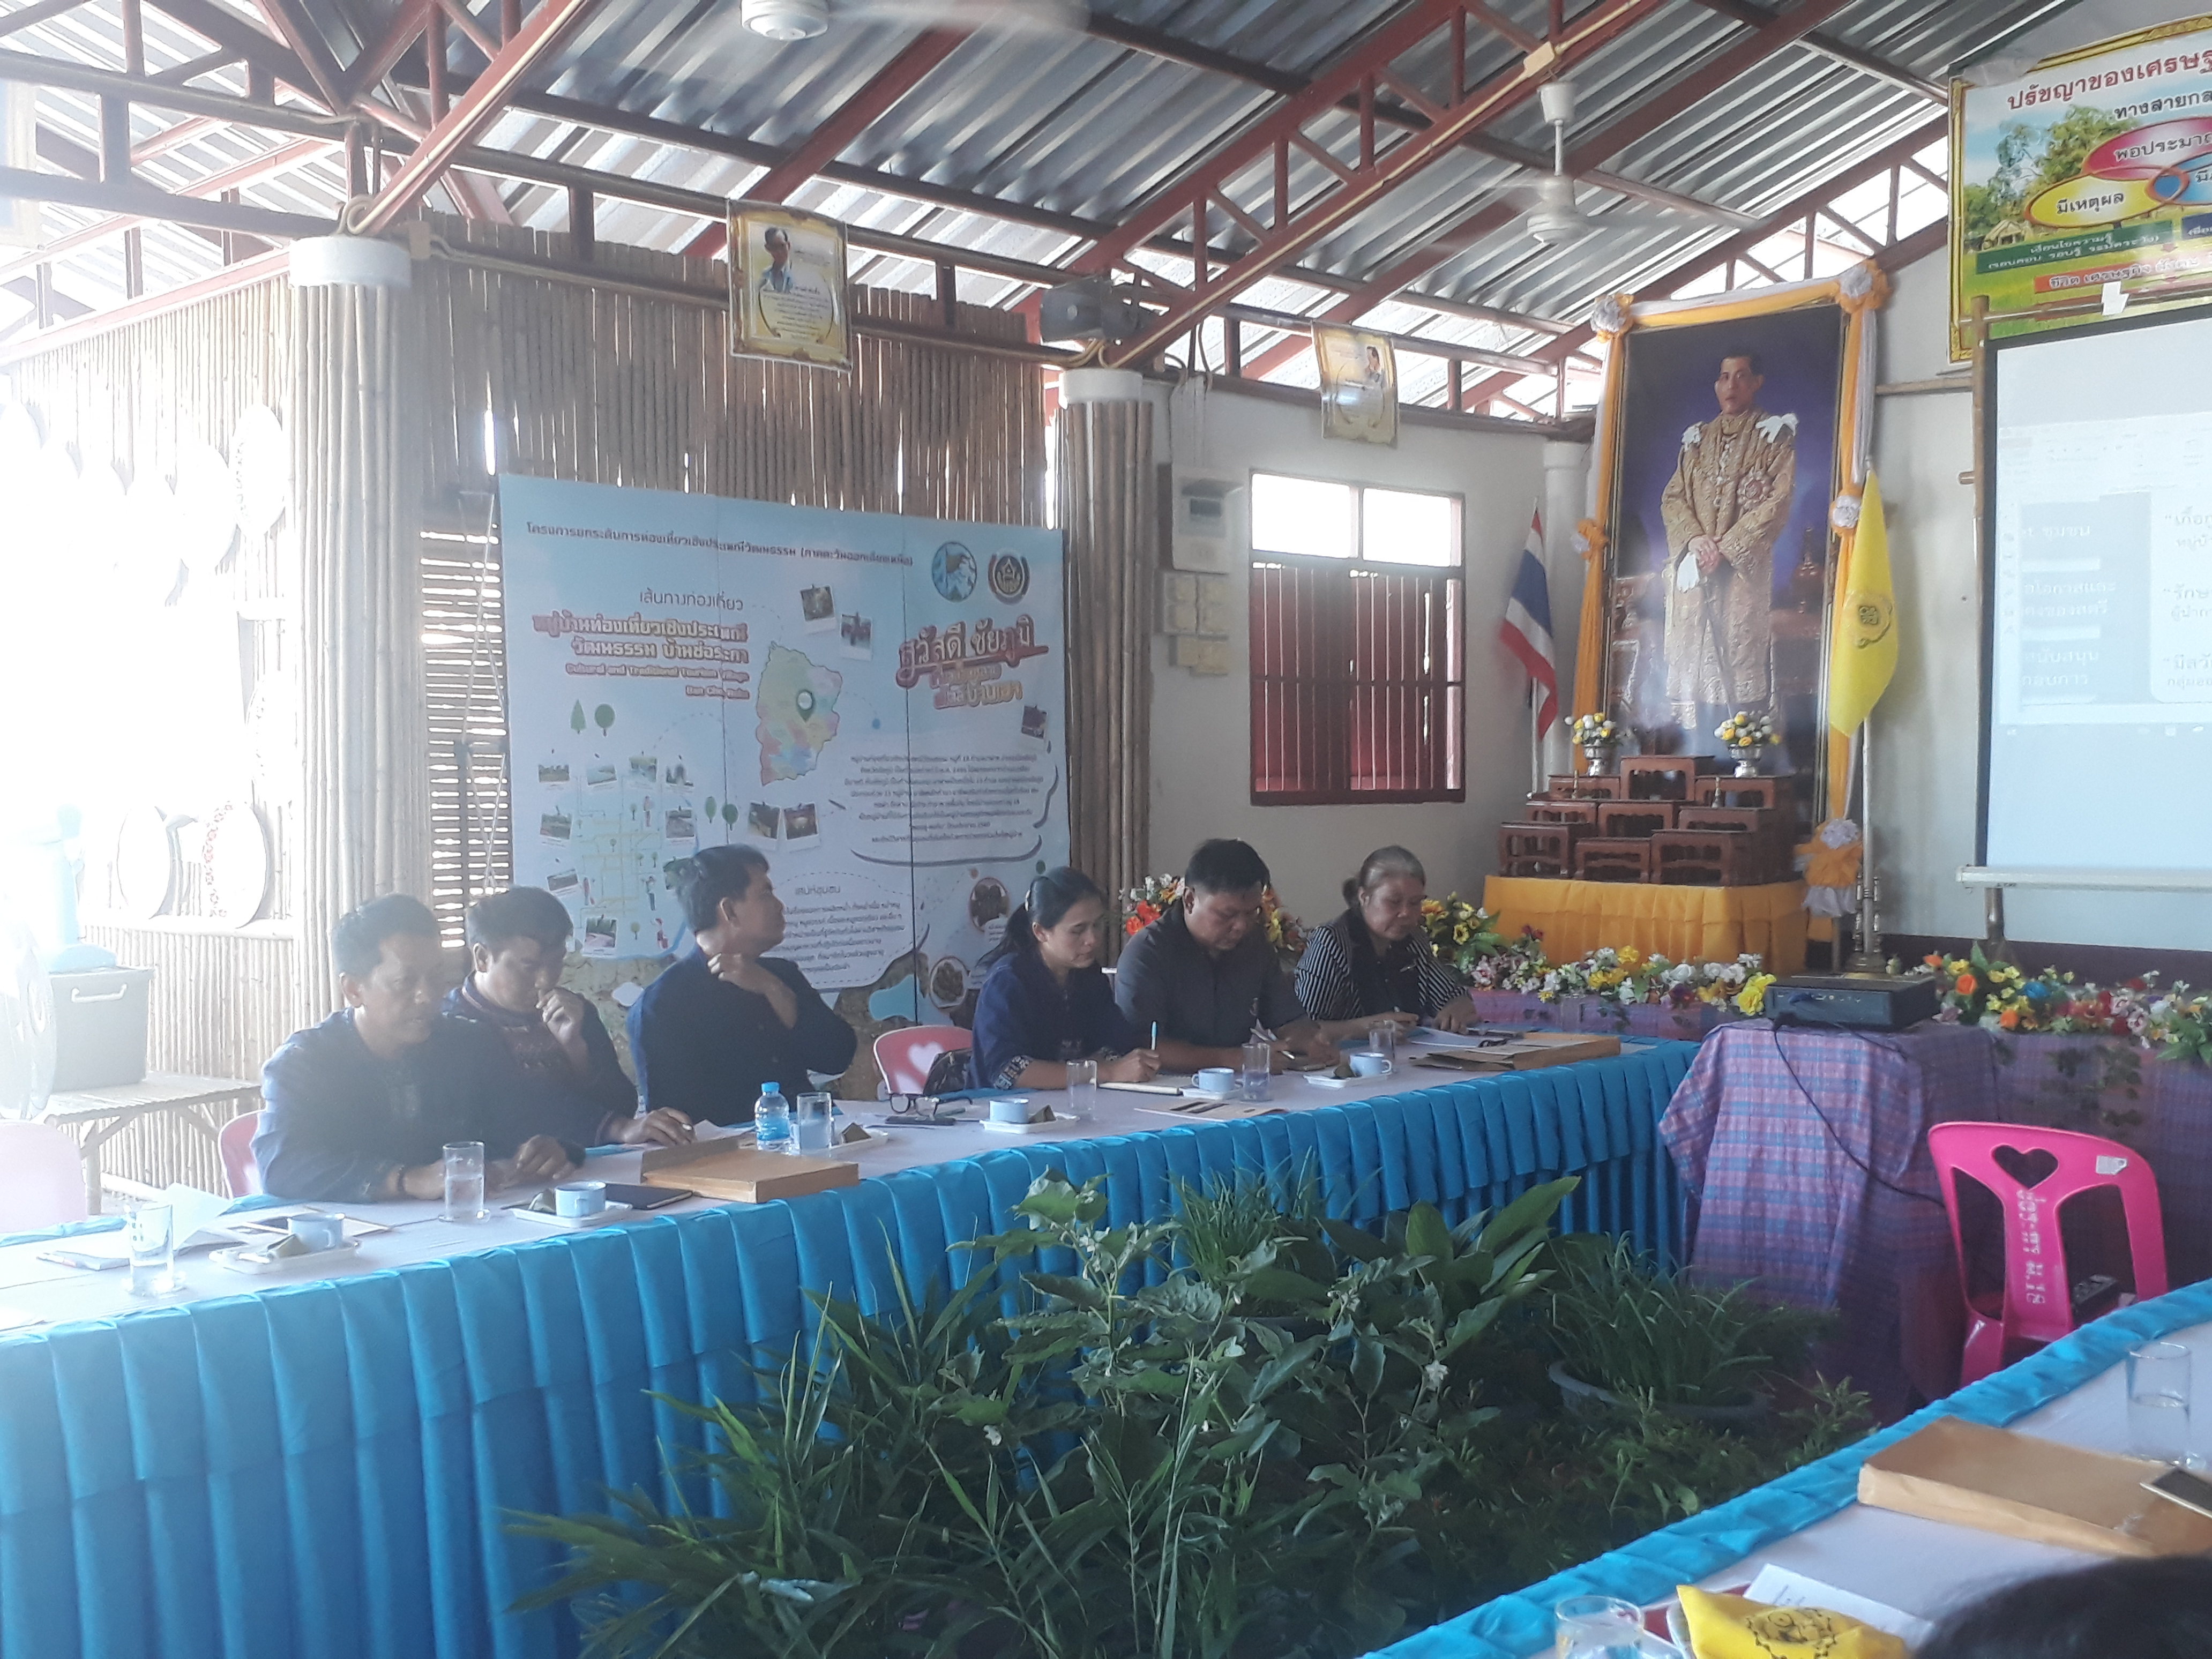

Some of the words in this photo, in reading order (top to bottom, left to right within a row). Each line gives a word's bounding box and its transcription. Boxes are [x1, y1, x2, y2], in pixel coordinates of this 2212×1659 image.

[2195, 169, 2212, 183] มี
[2056, 190, 2125, 215] มีเหตุผล
[640, 588, 744, 611] เส้นทางท่องเที่ยว
[572, 636, 657, 657] วัฒนธรรม
[663, 640, 749, 663] บ้านช่อระกา
[970, 614, 1035, 668] ชัยภูมิ
